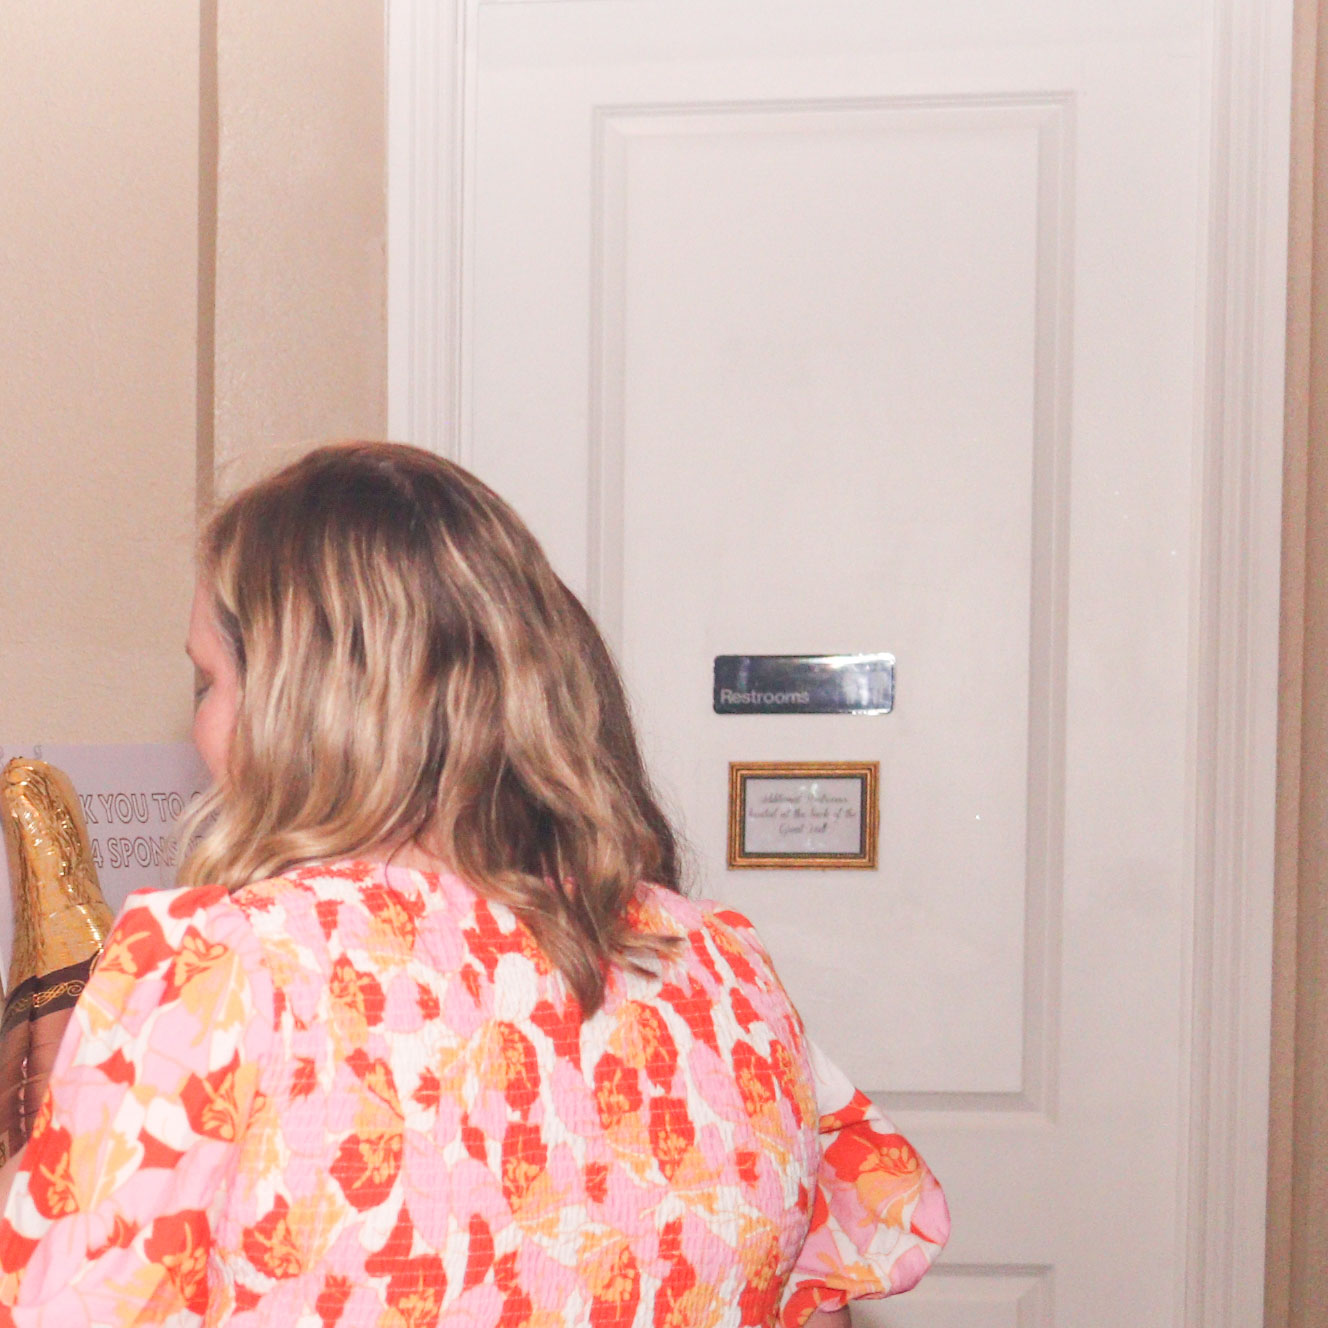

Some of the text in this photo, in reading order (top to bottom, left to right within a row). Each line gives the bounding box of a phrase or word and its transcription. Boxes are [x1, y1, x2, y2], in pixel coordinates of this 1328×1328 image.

[720, 688, 810, 705] Restrooms
[97, 793, 149, 824] YOU
[151, 791, 185, 823] TO
